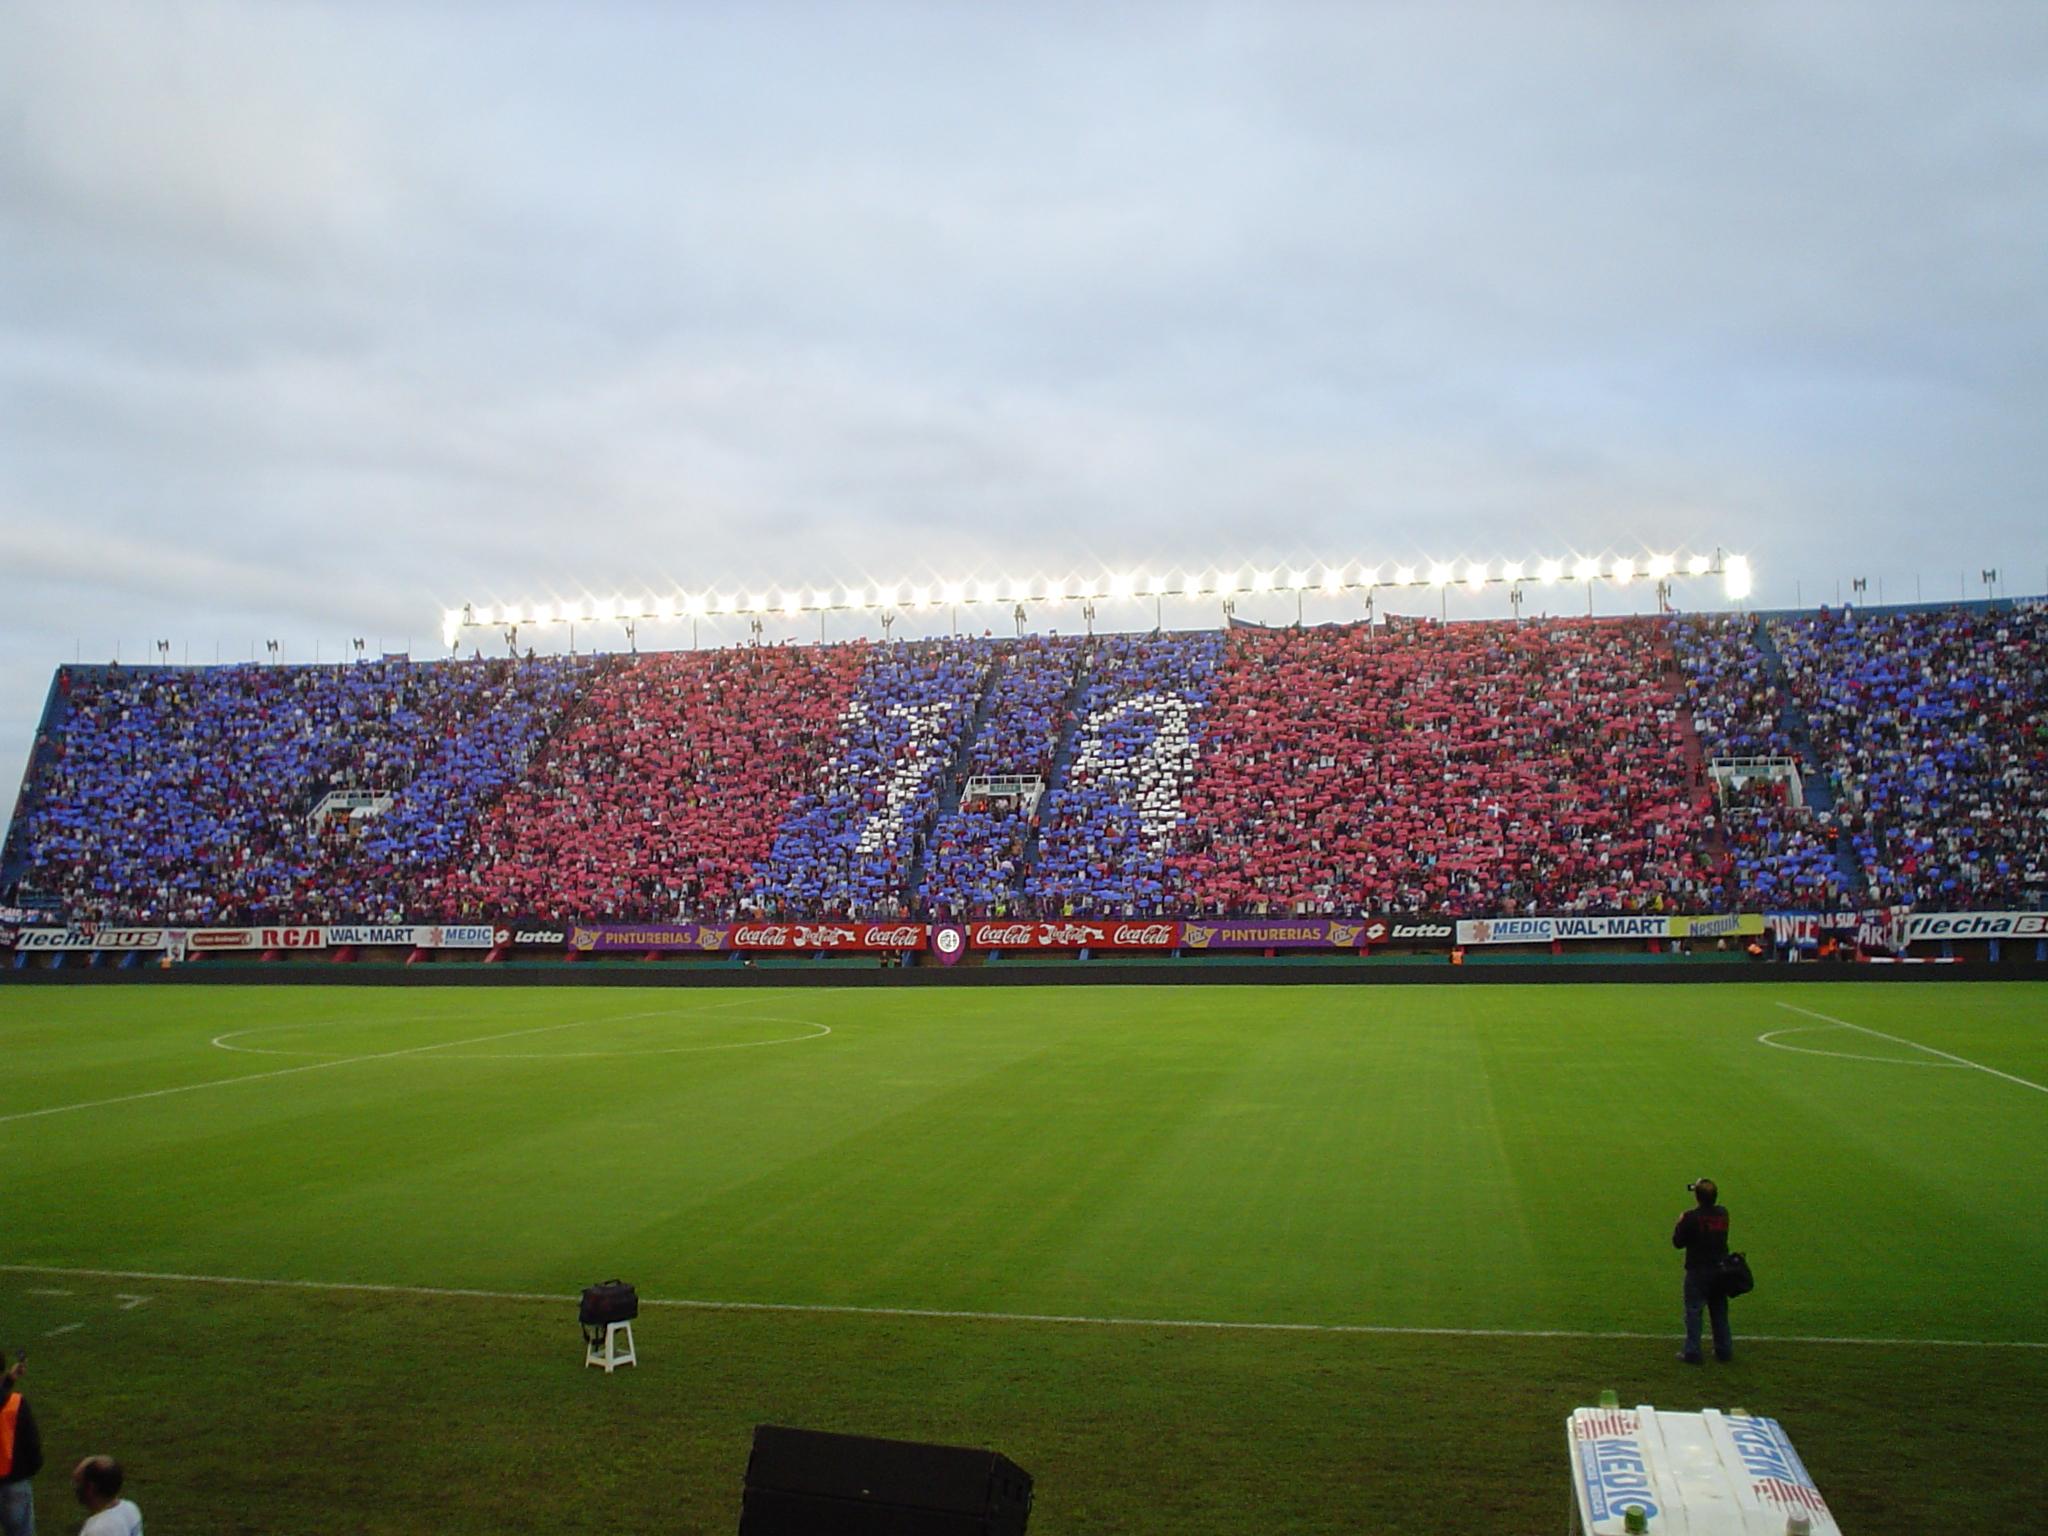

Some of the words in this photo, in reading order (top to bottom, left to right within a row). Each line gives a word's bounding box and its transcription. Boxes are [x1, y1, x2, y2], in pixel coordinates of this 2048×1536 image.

[1493, 920, 1551, 934] MEDIC
[1910, 916, 2012, 935] flecha
[2018, 917, 2048, 933] B
[98, 931, 161, 947] BUS
[261, 929, 320, 946] RCA
[445, 928, 492, 940] MEDIC
[605, 931, 692, 945] PINTURERIAS
[1221, 927, 1322, 941] PINTURERIAS
[1596, 1438, 1659, 1520] MEDIC
